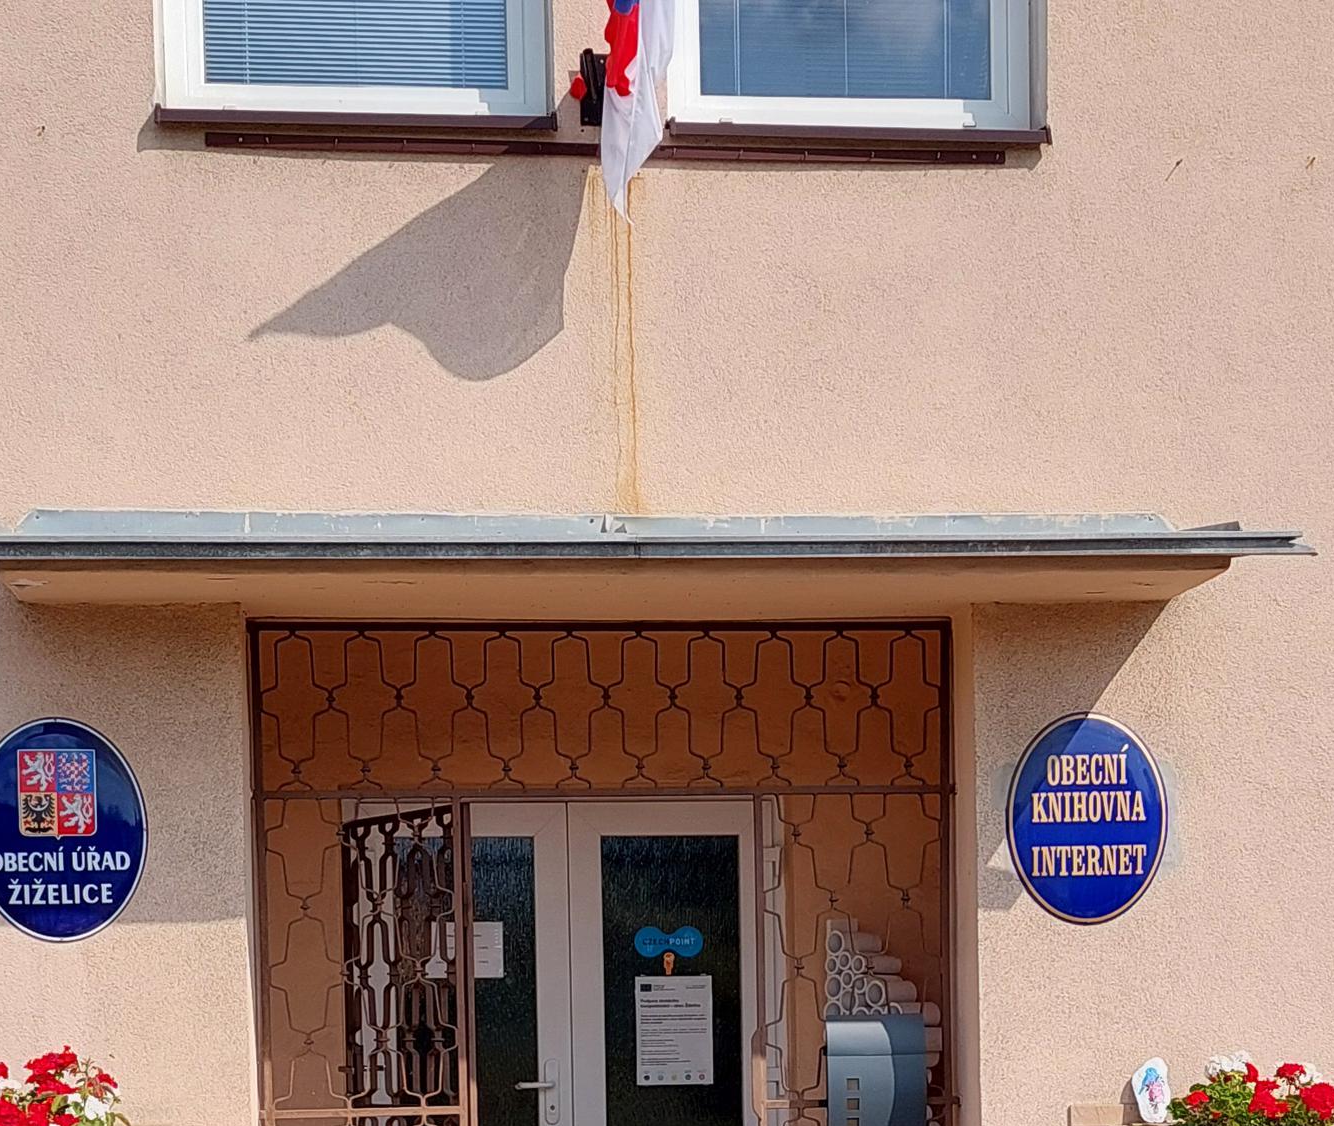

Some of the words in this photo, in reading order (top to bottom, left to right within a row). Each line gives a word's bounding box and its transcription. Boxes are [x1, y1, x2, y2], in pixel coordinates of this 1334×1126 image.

[1046, 743, 1129, 787] OBECNÍ
[1031, 790, 1146, 824] KNIHOVNA
[72, 845, 131, 872] ÚŘAD
[1031, 844, 1147, 877] INTERNET
[7, 878, 113, 906] ŽIŽELICE
